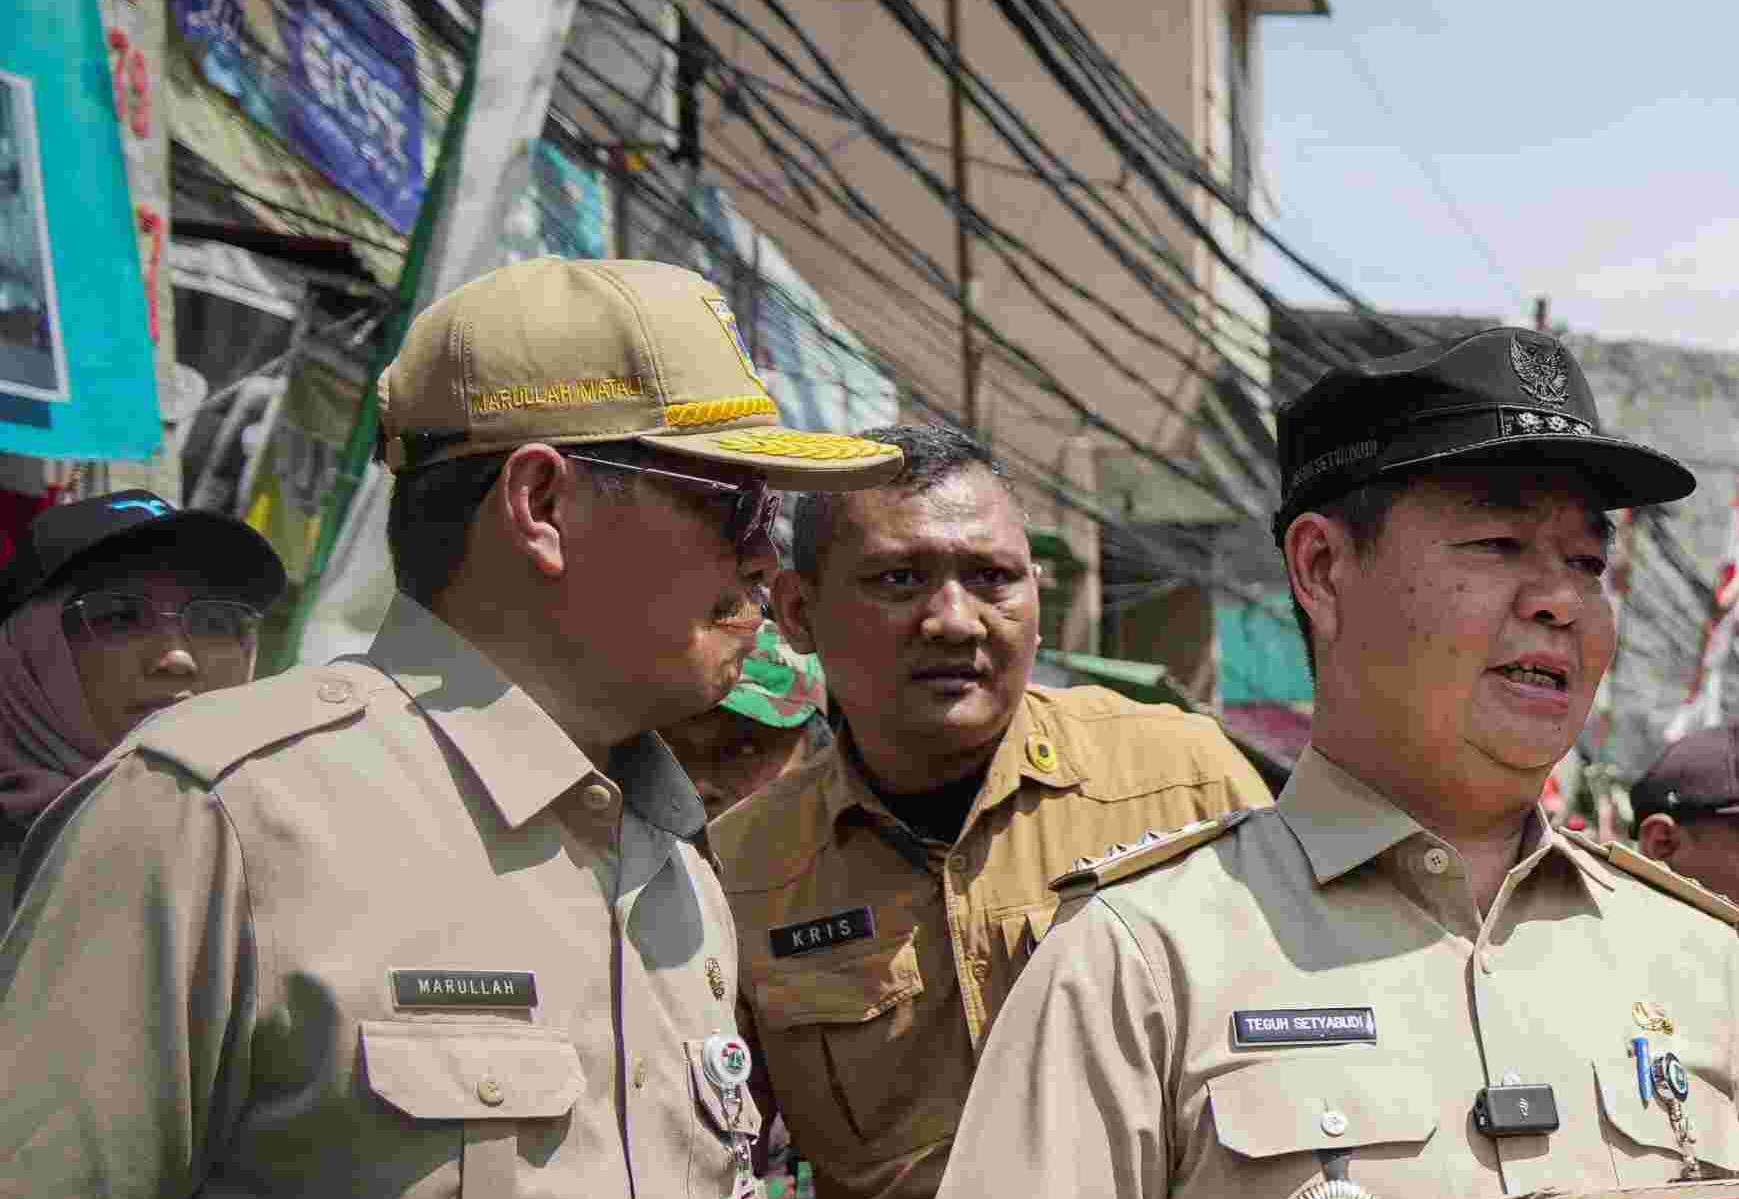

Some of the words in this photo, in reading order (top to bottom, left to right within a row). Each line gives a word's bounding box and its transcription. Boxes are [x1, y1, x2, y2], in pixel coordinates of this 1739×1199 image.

[472, 383, 573, 411] MARULLAH
[792, 920, 851, 947] KRIS
[418, 979, 514, 995] MARULLAH
[1246, 1017, 1289, 1031] TEGUH
[1294, 1015, 1364, 1030] SETYABUDI
